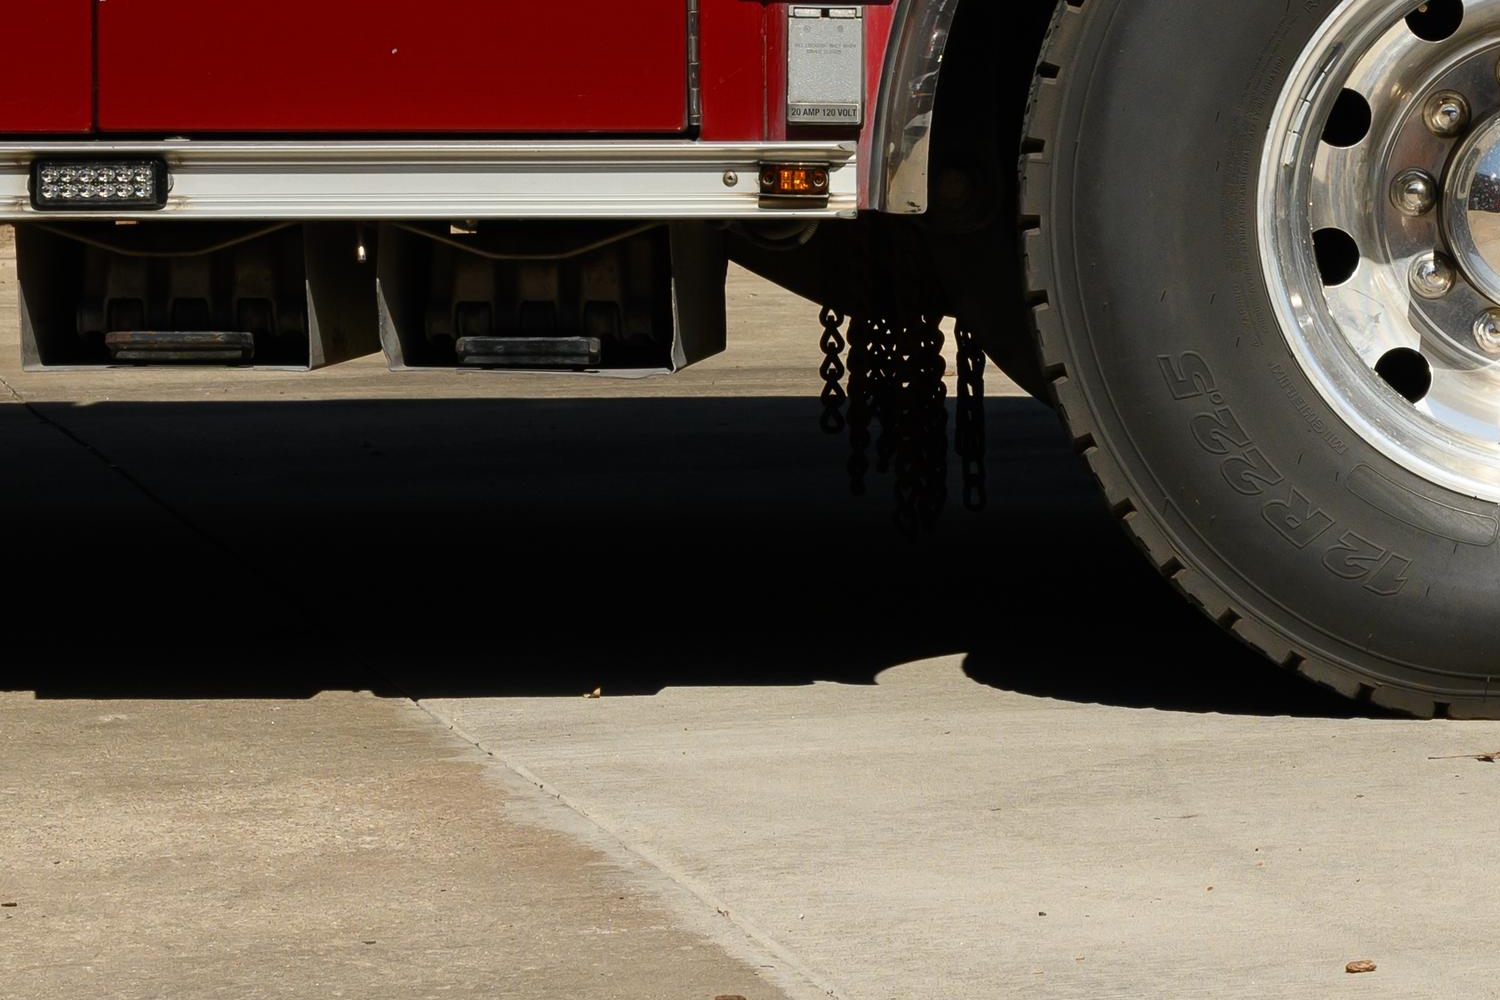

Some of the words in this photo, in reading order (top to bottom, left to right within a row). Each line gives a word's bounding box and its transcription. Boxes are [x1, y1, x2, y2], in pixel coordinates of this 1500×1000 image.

[791, 107, 801, 117] 20
[803, 108, 820, 116] AMP
[822, 108, 836, 117] 120
[837, 108, 857, 117] VOLT
[1268, 360, 1349, 456] MICHELIN
